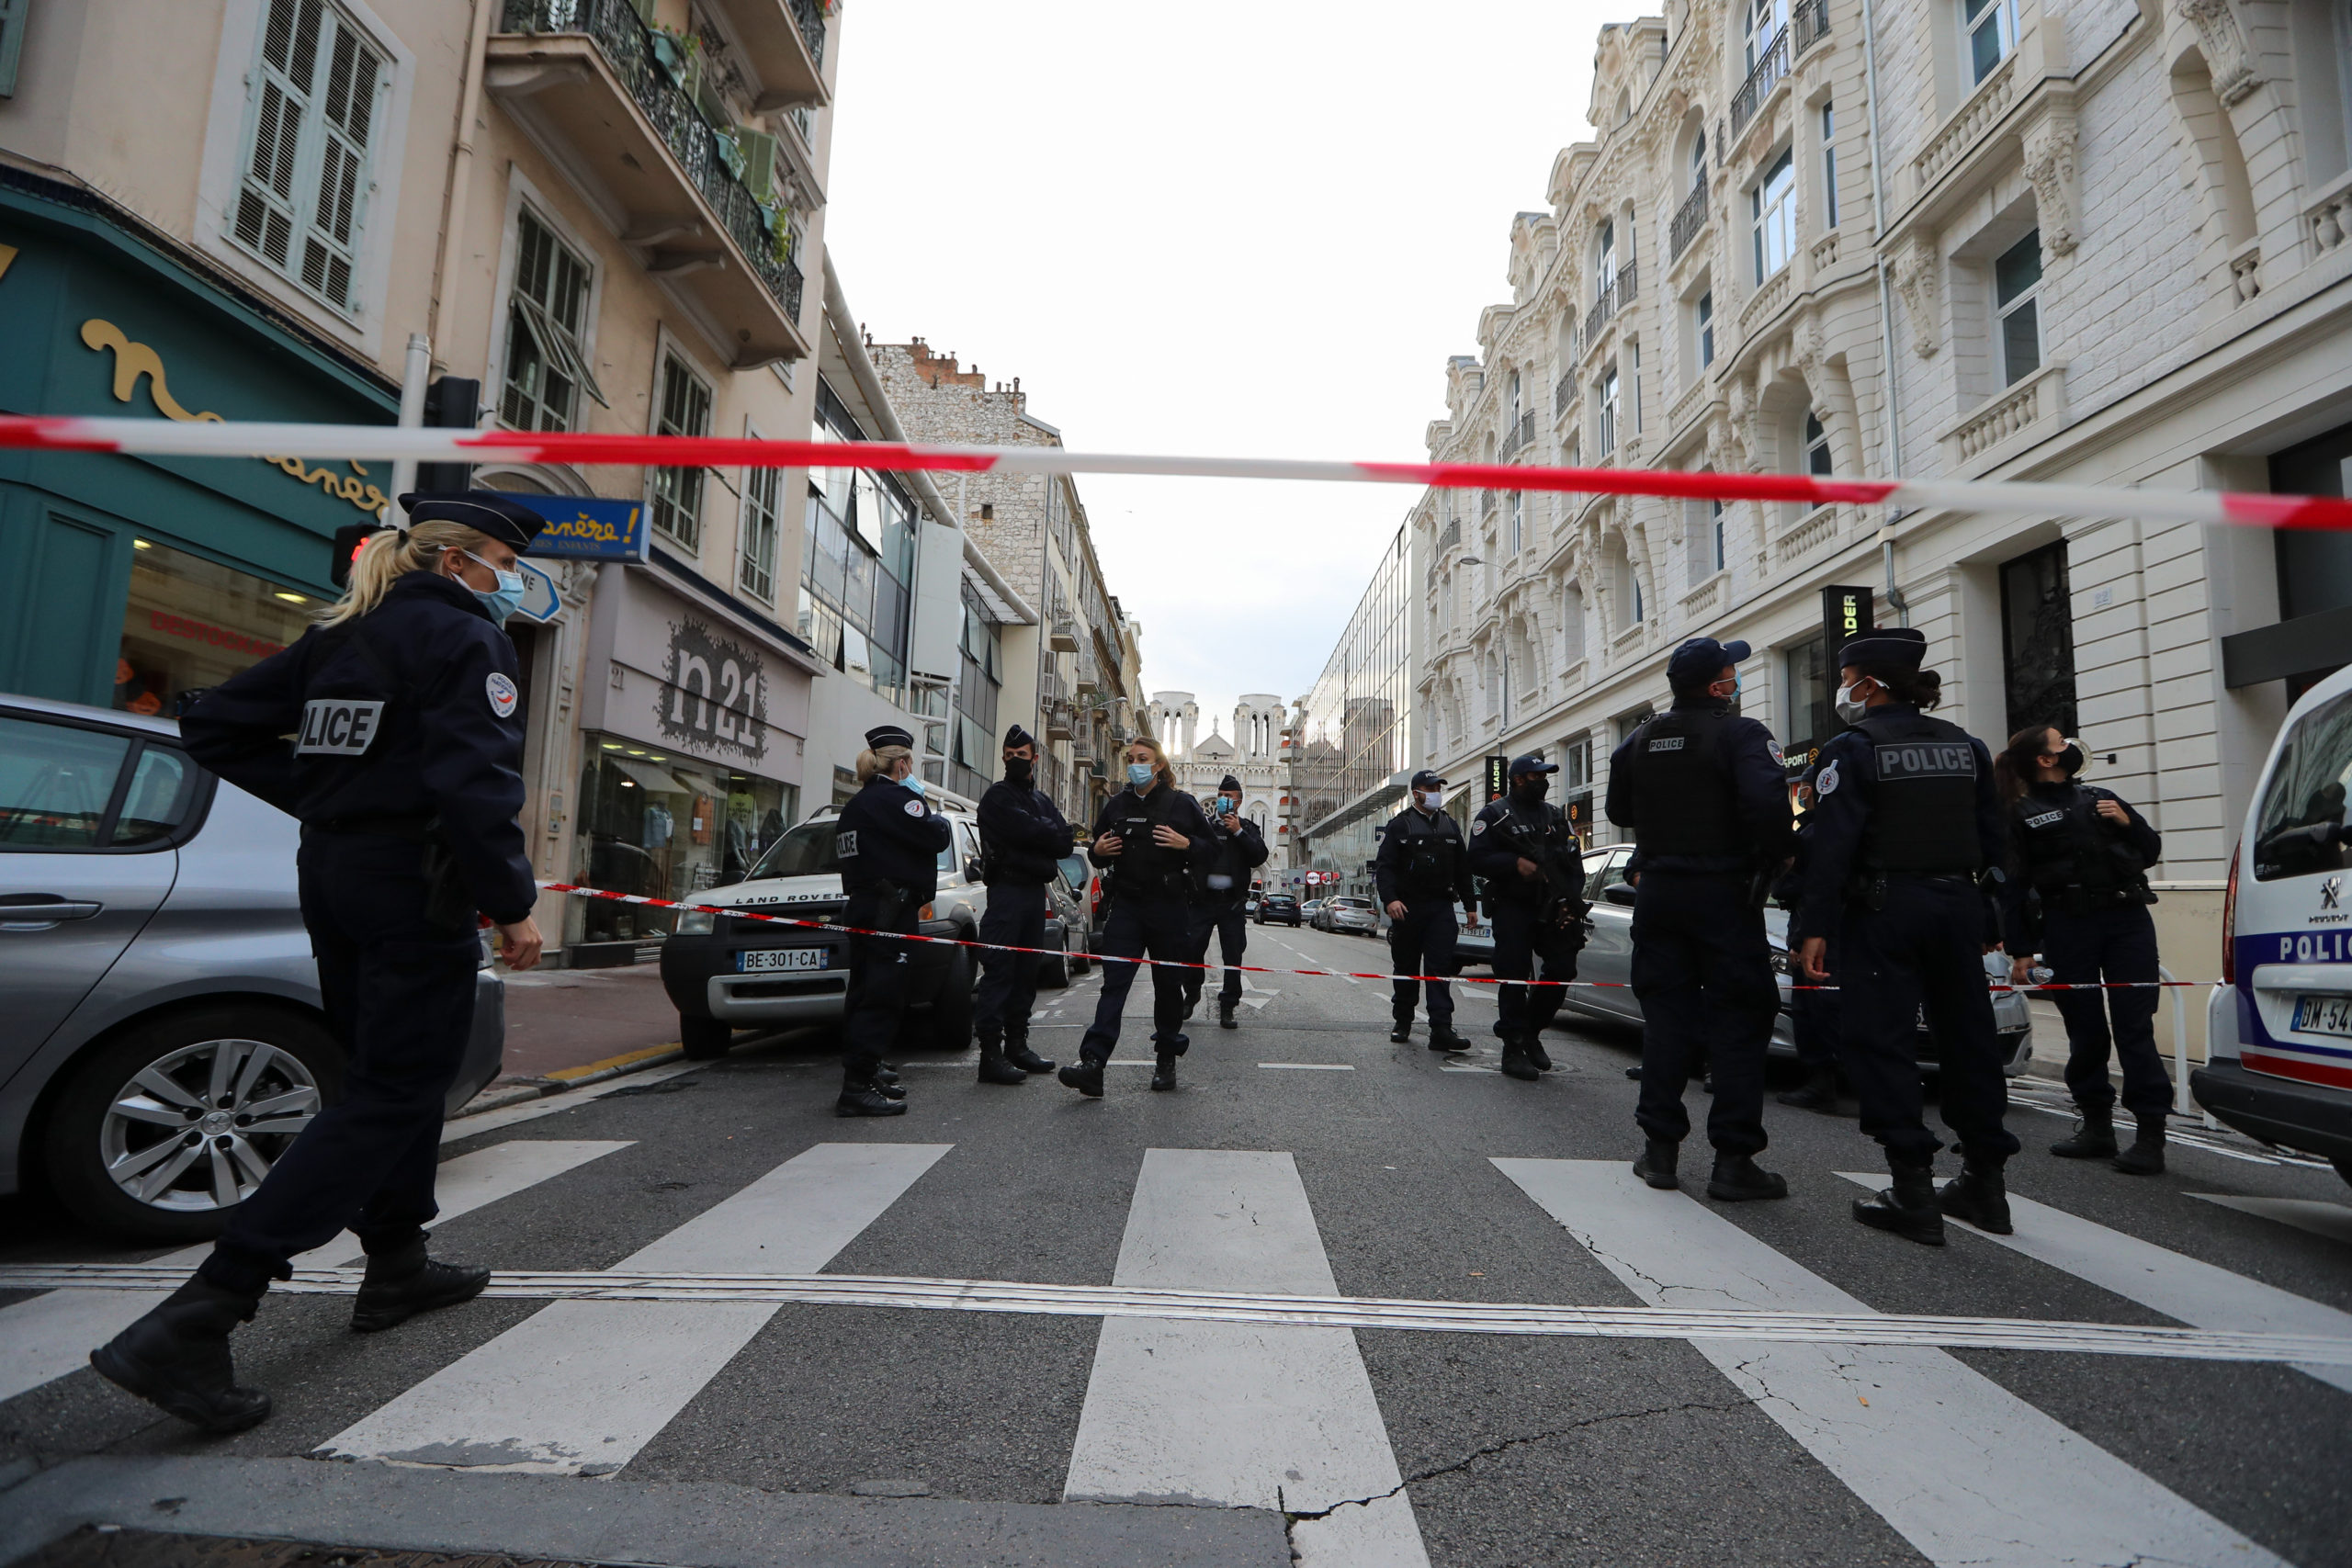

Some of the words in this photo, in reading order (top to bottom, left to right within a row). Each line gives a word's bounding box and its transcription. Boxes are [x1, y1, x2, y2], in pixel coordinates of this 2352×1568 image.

[303, 706, 373, 748] LICE
[1650, 739, 1683, 750] POLICE
[1881, 748, 1973, 773] POLICE
[735, 897, 779, 905] LAND
[787, 893, 844, 901] ROVER
[746, 952, 818, 968] BE-301-CA
[2279, 934, 2352, 961] POLI
[2301, 1000, 2352, 1032] DM-54
